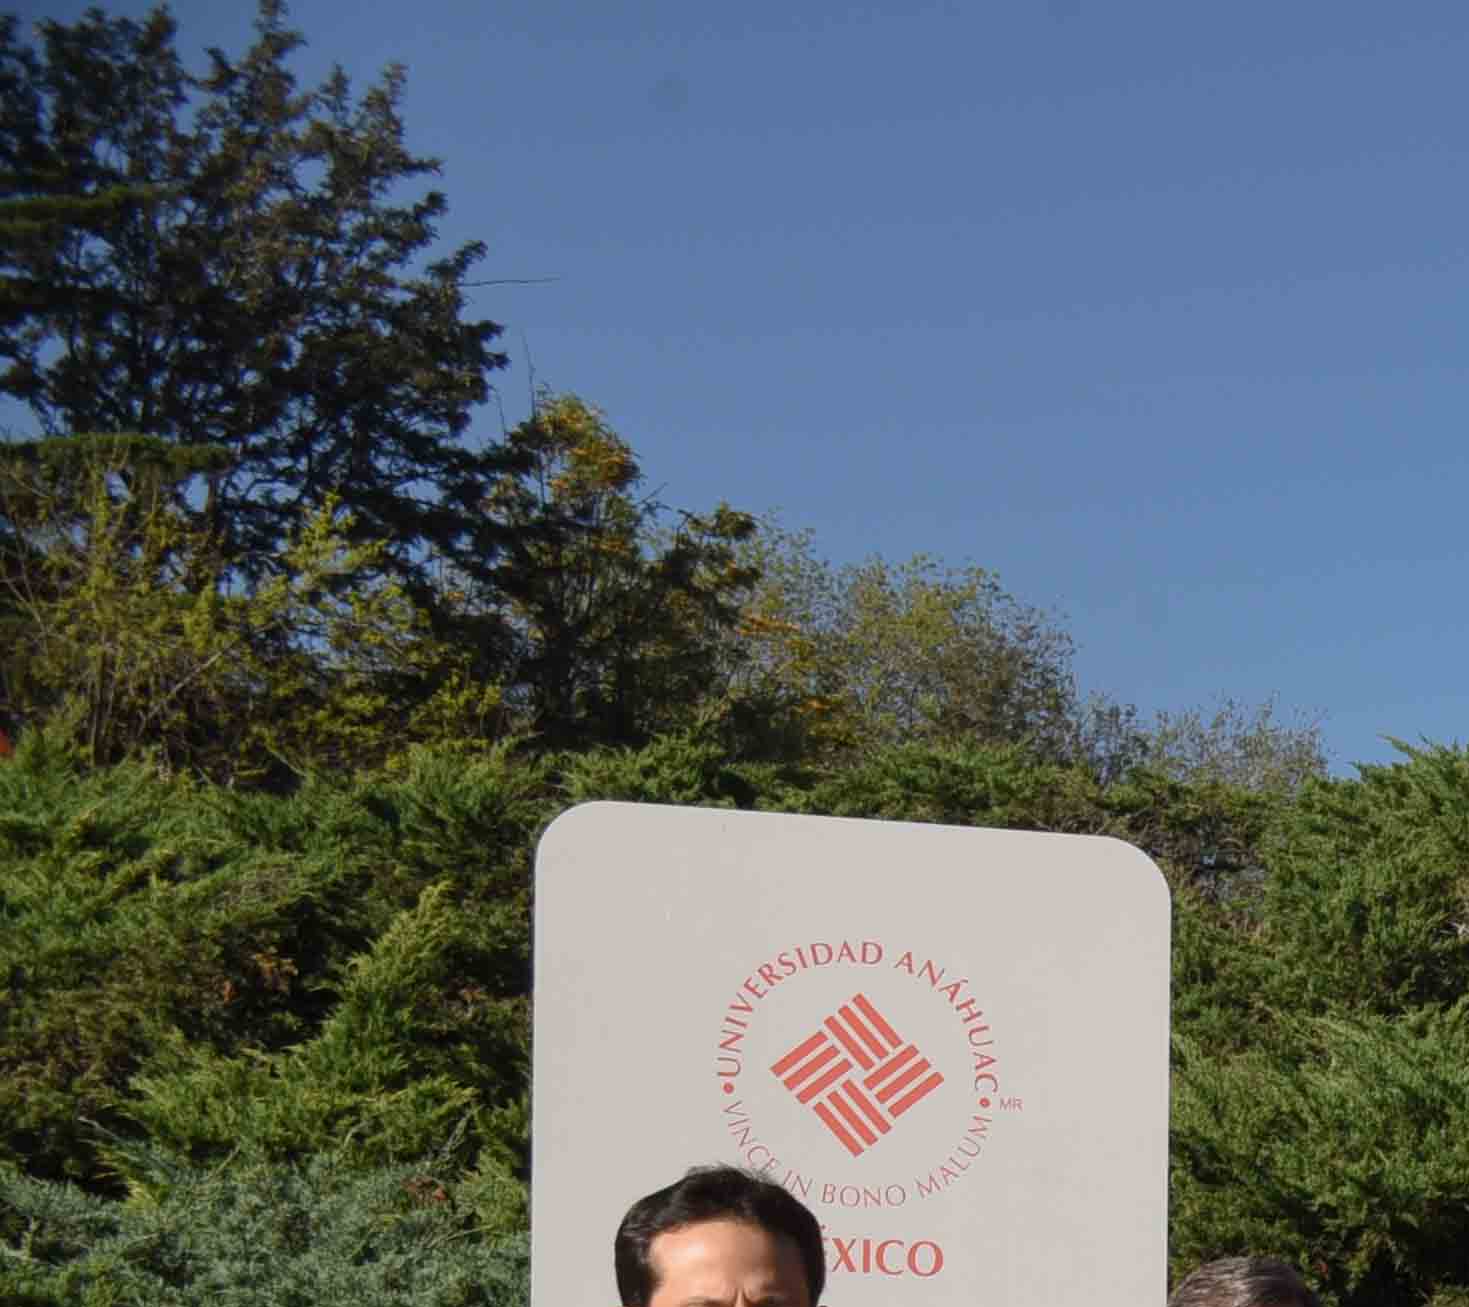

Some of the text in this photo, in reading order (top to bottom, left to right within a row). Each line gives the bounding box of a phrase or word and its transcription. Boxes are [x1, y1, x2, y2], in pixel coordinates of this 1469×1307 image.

[717, 941, 998, 1093] UNIVERSIDAD ANÁHUAC
[1000, 1099, 1022, 1111] MR
[783, 1170, 813, 1197] IN
[821, 1184, 906, 1207] BONO
[915, 1115, 992, 1198] MALUM
[823, 1226, 944, 1277] XICO
